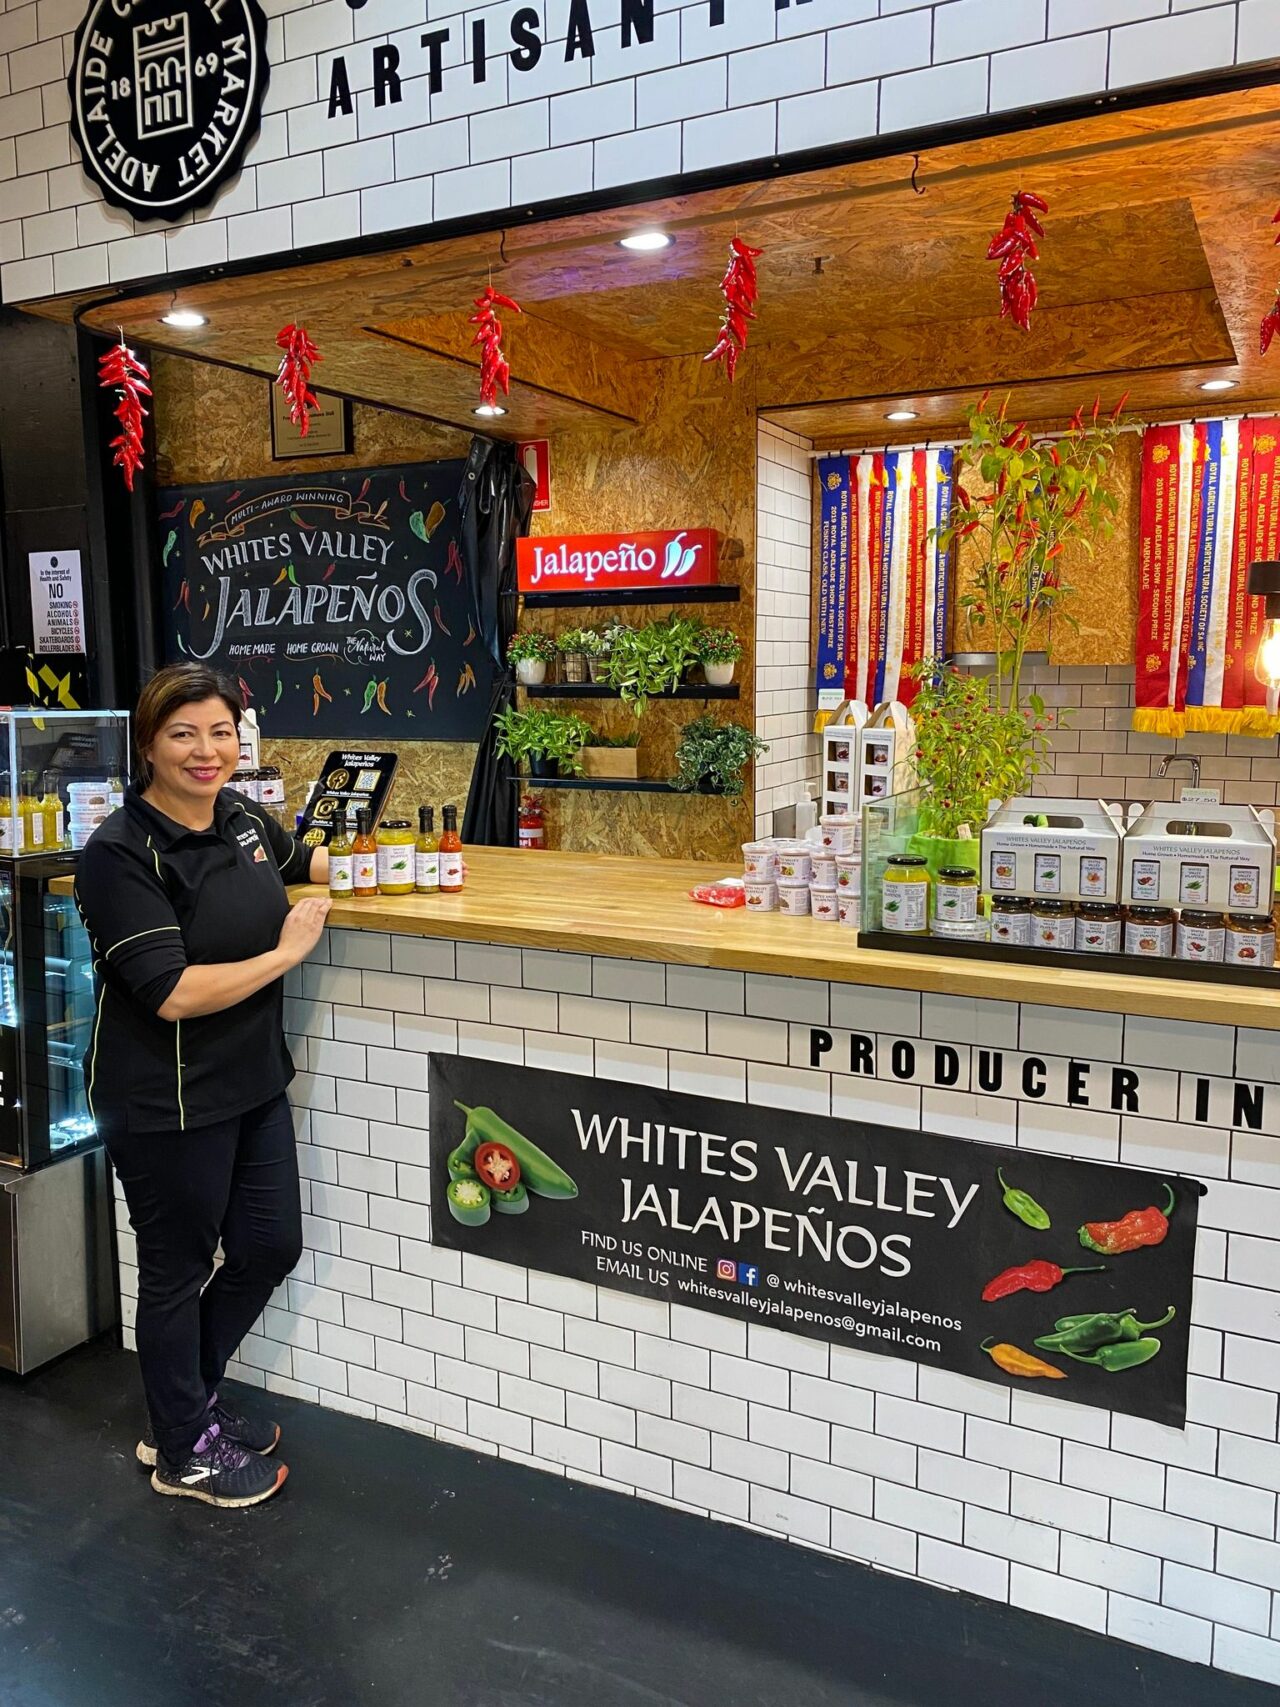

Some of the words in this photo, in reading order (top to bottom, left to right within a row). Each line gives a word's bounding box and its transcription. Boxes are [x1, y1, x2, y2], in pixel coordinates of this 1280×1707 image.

[194, 52, 219, 77] 69
[327, 0, 654, 119] ARTISAN
[110, 77, 131, 100] 18
[84, 30, 160, 192] ADELAIDE
[178, 33, 247, 187] MARKET
[1209, 462, 1217, 484] ROYAL
[1259, 474, 1267, 500] ROYAL
[231, 494, 293, 525] MULTI-AWARD
[295, 492, 344, 503] WINNING
[1155, 498, 1163, 522] ROYAL
[1168, 488, 1176, 536] AGRICULTURAL
[1191, 489, 1200, 537] AGRICULTURAL
[1206, 486, 1216, 535] AGRICULTURAL
[1239, 482, 1248, 531] AGRICULTURAL
[1256, 504, 1266, 543] ADELAIDE
[884, 512, 892, 556] AGRICULTURAL
[200, 533, 292, 575] WHITES
[299, 531, 394, 565] VALLEY
[530, 542, 656, 584] Jalapeño
[1165, 543, 1174, 593] HORTICULTURAL
[1185, 544, 1196, 596] HORTICULTURAL
[1202, 543, 1212, 593] HORTICULTURAL
[1237, 539, 1246, 591] HORTICULTURAL
[48, 583, 64, 599] NO
[881, 563, 889, 609] HORTICULTURAL
[1153, 563, 1161, 584] SHOW
[46, 610, 72, 618] ALCOHOL
[49, 601, 72, 609] SMOKING
[188, 568, 437, 659] JALAPEÑOS
[1152, 589, 1160, 618] SECOND
[1164, 595, 1173, 621] SOCIETY
[1183, 598, 1192, 623] SOCIETY
[1236, 593, 1244, 618] SOCIETY
[39, 636, 74, 644] SKATEBOARDS
[51, 627, 73, 635] BICYCLES
[1250, 612, 1258, 635] PRIZE
[39, 644, 75, 652] ROLLERBLADES
[286, 642, 308, 655] HOME
[311, 642, 339, 653] GROWN
[369, 653, 386, 662] WAY
[363, 754, 381, 762] Valley
[1153, 845, 1179, 853] WHITES
[1179, 846, 1202, 854] VALLEY
[810, 1028, 1140, 1113] PRODUCER
[1195, 1078, 1265, 1131] IN
[571, 1109, 759, 1183] WHITES
[774, 1146, 980, 1229] VALLEY
[621, 1178, 913, 1279] JALAPEÑOS
[581, 1230, 618, 1250] FIND
[622, 1240, 643, 1257] US
[647, 1247, 708, 1273] ONLINE
[784, 1278, 962, 1331] whitesvalleyjalapenos
[596, 1256, 644, 1281] EMAIL
[648, 1268, 670, 1287] US
[678, 1279, 941, 1352] whitesvalleyjalapenos@gmail.com
